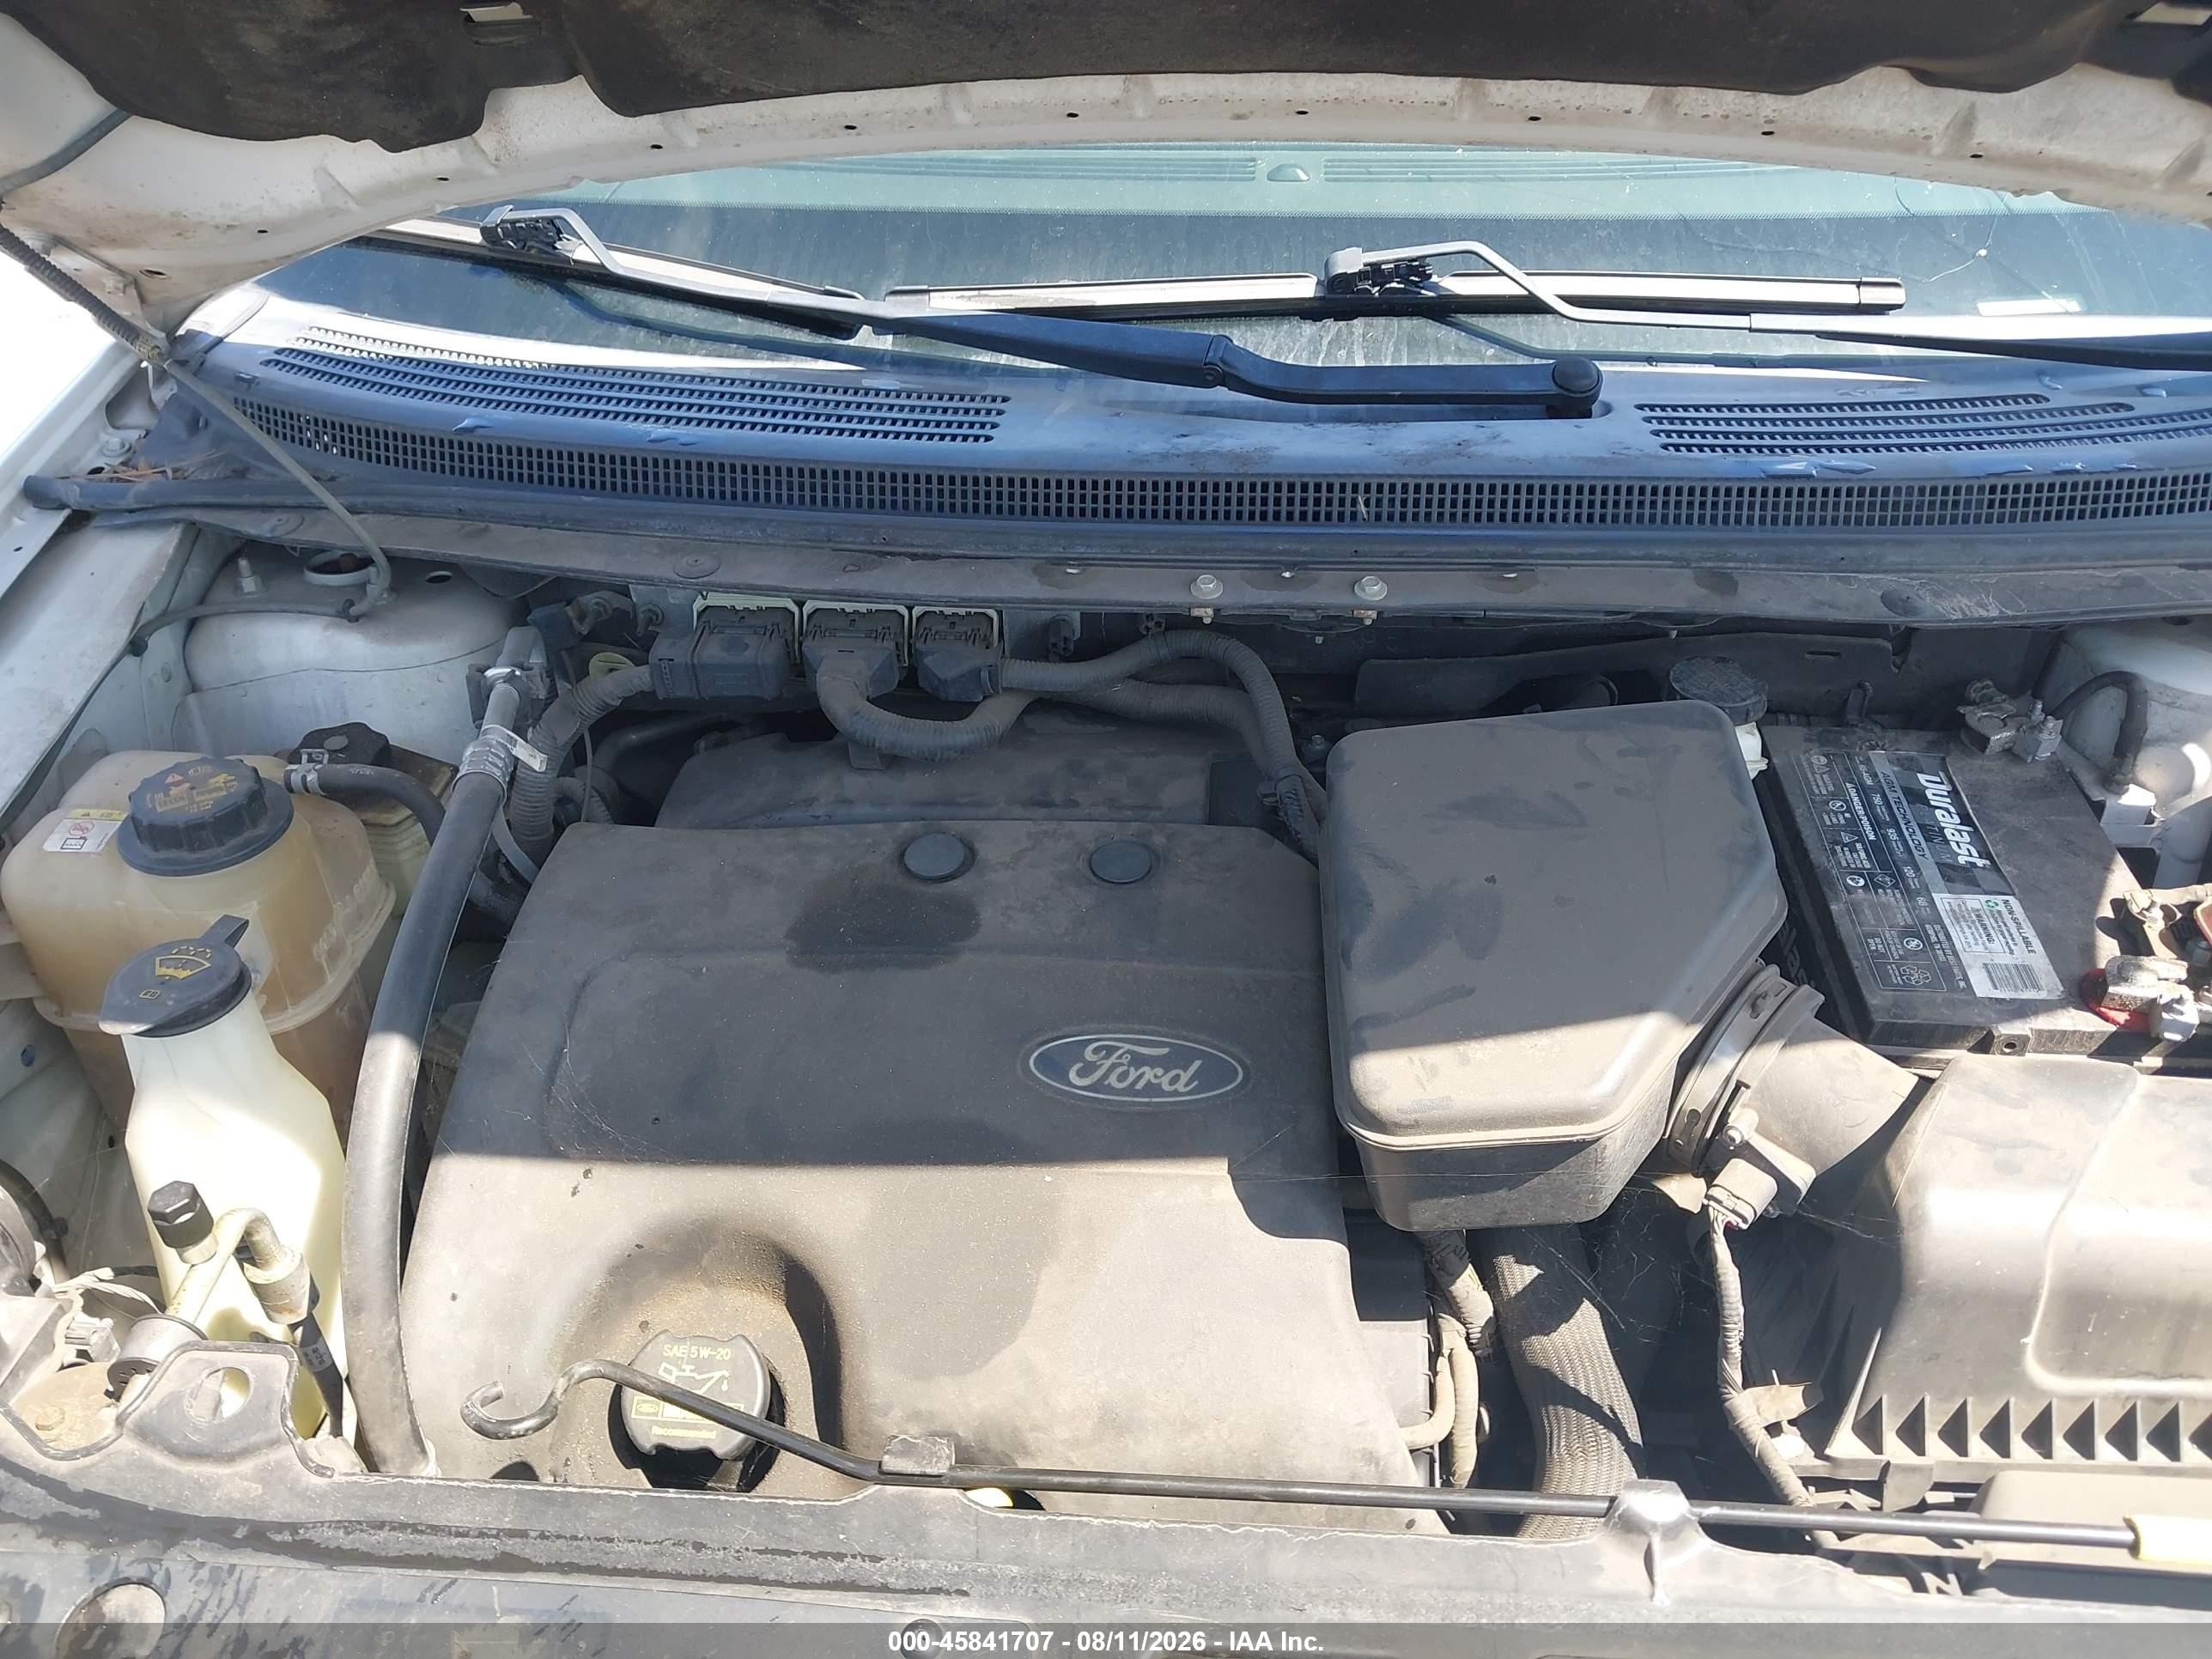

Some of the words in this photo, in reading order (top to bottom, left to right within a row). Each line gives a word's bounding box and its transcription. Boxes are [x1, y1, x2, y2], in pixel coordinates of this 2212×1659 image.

[1869, 793, 1883, 805] 750
[1879, 771, 1898, 793] AGM
[1890, 795, 1929, 860] TECHNOLOGY
[1915, 770, 1991, 867] Duralast
[1885, 828, 1899, 841] 935
[1901, 866, 1916, 877] 120
[1972, 913, 1996, 944] WARNING:
[2001, 899, 2037, 954] NON-SPILLABLE
[1069, 1041, 1202, 1092] Ford
[662, 1344, 688, 1358] SAE
[690, 1347, 732, 1360] 5W-20
